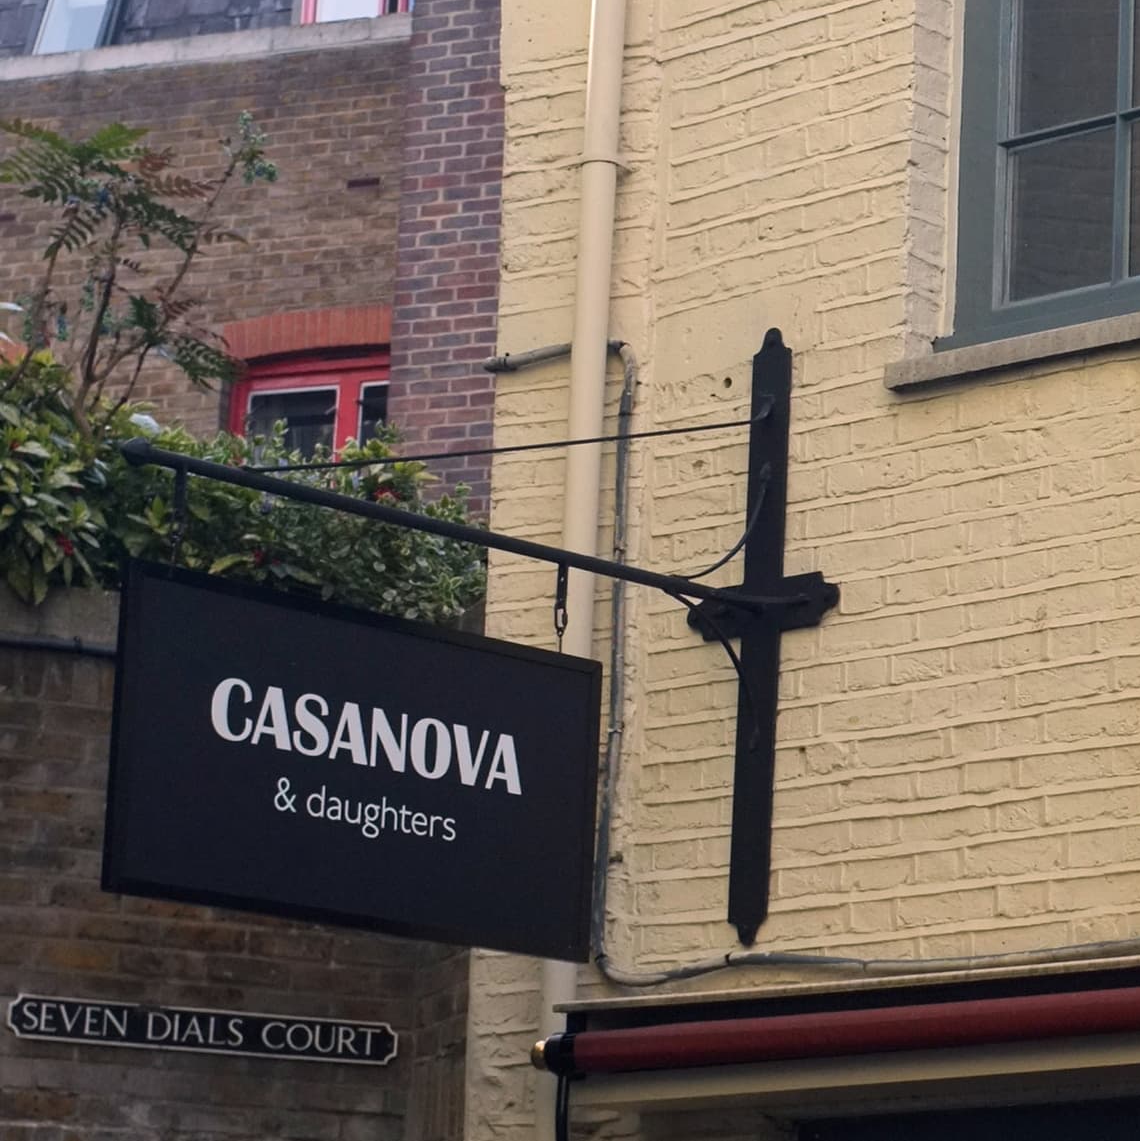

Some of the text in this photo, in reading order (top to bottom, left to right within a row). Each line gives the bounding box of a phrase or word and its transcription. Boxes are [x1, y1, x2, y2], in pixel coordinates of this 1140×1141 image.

[210, 677, 522, 796] CASANOVA
[273, 776, 456, 842] & daughters
[22, 1002, 381, 1055] SEVEN DIALS COURT
